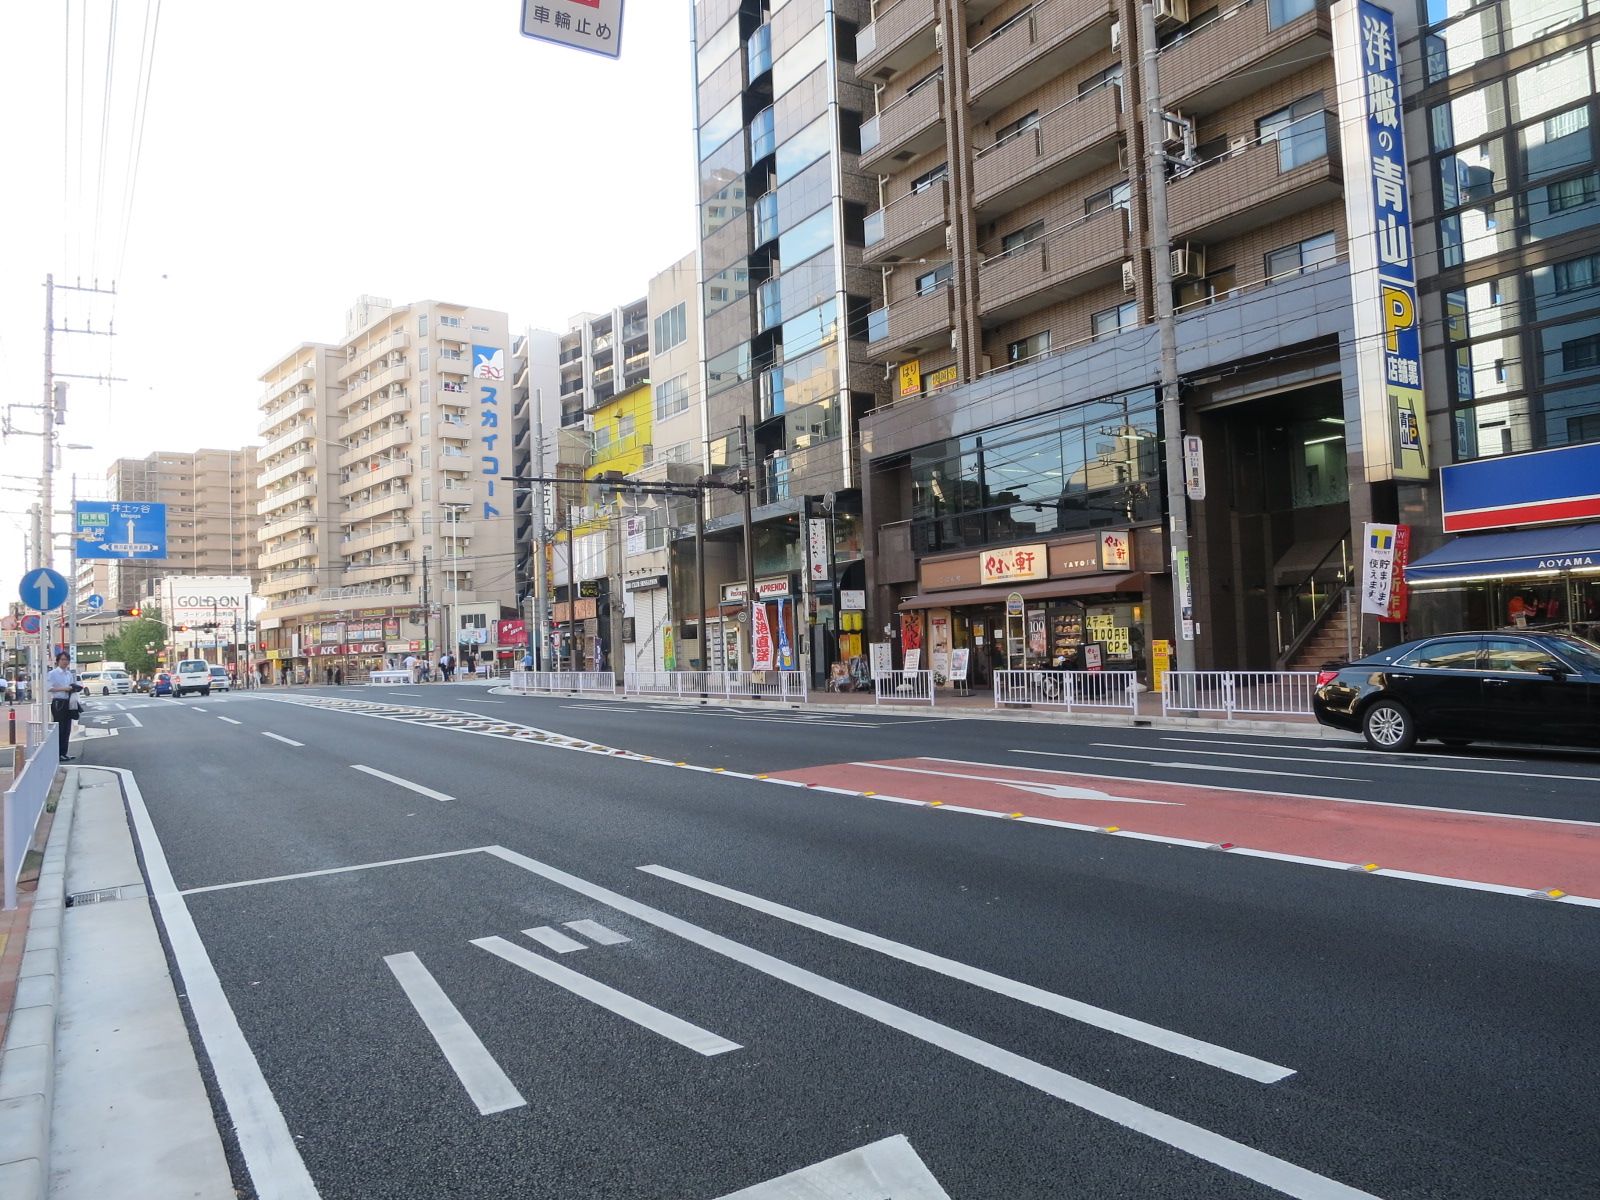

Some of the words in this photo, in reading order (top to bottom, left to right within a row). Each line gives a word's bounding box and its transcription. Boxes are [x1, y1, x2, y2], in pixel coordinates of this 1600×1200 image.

[533, 5, 612, 40] 車輪止め
[1363, 15, 1408, 267] 洋服の青山
[1382, 285, 1414, 354] P
[902, 364, 917, 378] はり
[480, 386, 500, 520] スカイコート
[1116, 548, 1127, 561] 軒
[985, 551, 1035, 576] やよい軒
[1538, 556, 1593, 569] AOYAMA
[759, 582, 787, 593] APRENDO
[1029, 620, 1045, 633] 100
[1086, 616, 1113, 629] ステーキ
[320, 646, 338, 656] KFC
[361, 644, 379, 653] KFC
